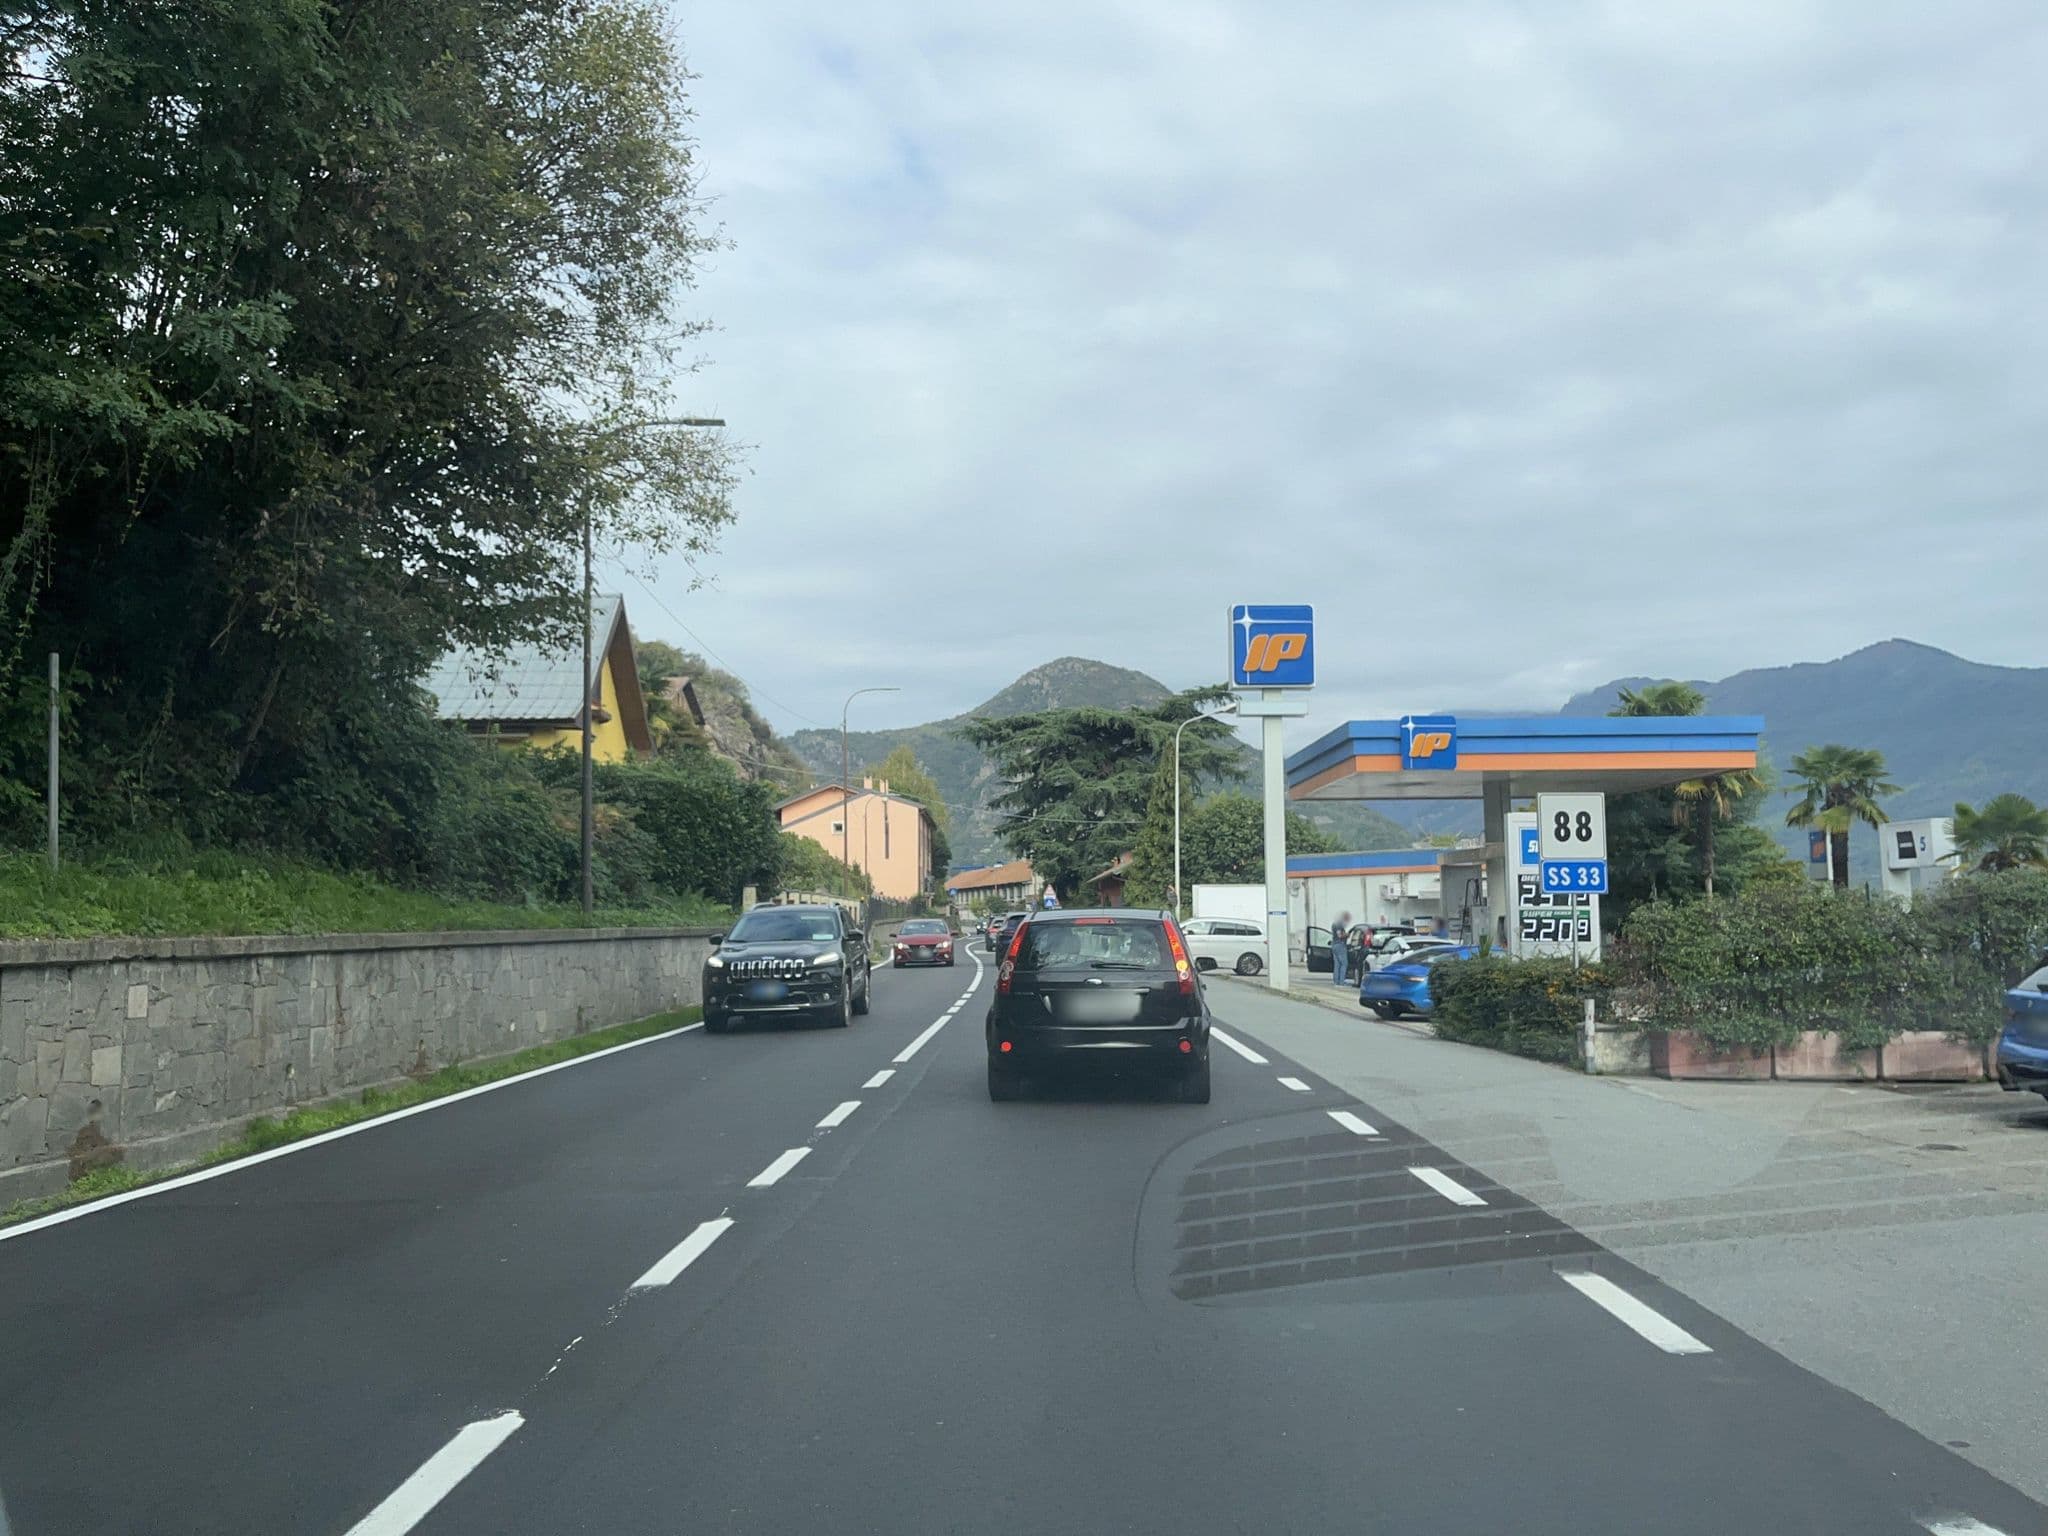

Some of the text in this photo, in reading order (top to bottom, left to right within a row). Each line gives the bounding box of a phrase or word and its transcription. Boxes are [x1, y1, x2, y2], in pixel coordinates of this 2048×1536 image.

[1243, 633, 1307, 672] IP
[1409, 733, 1452, 758] IP
[1554, 811, 1593, 842] 88
[1548, 867, 1600, 886] SS 33
